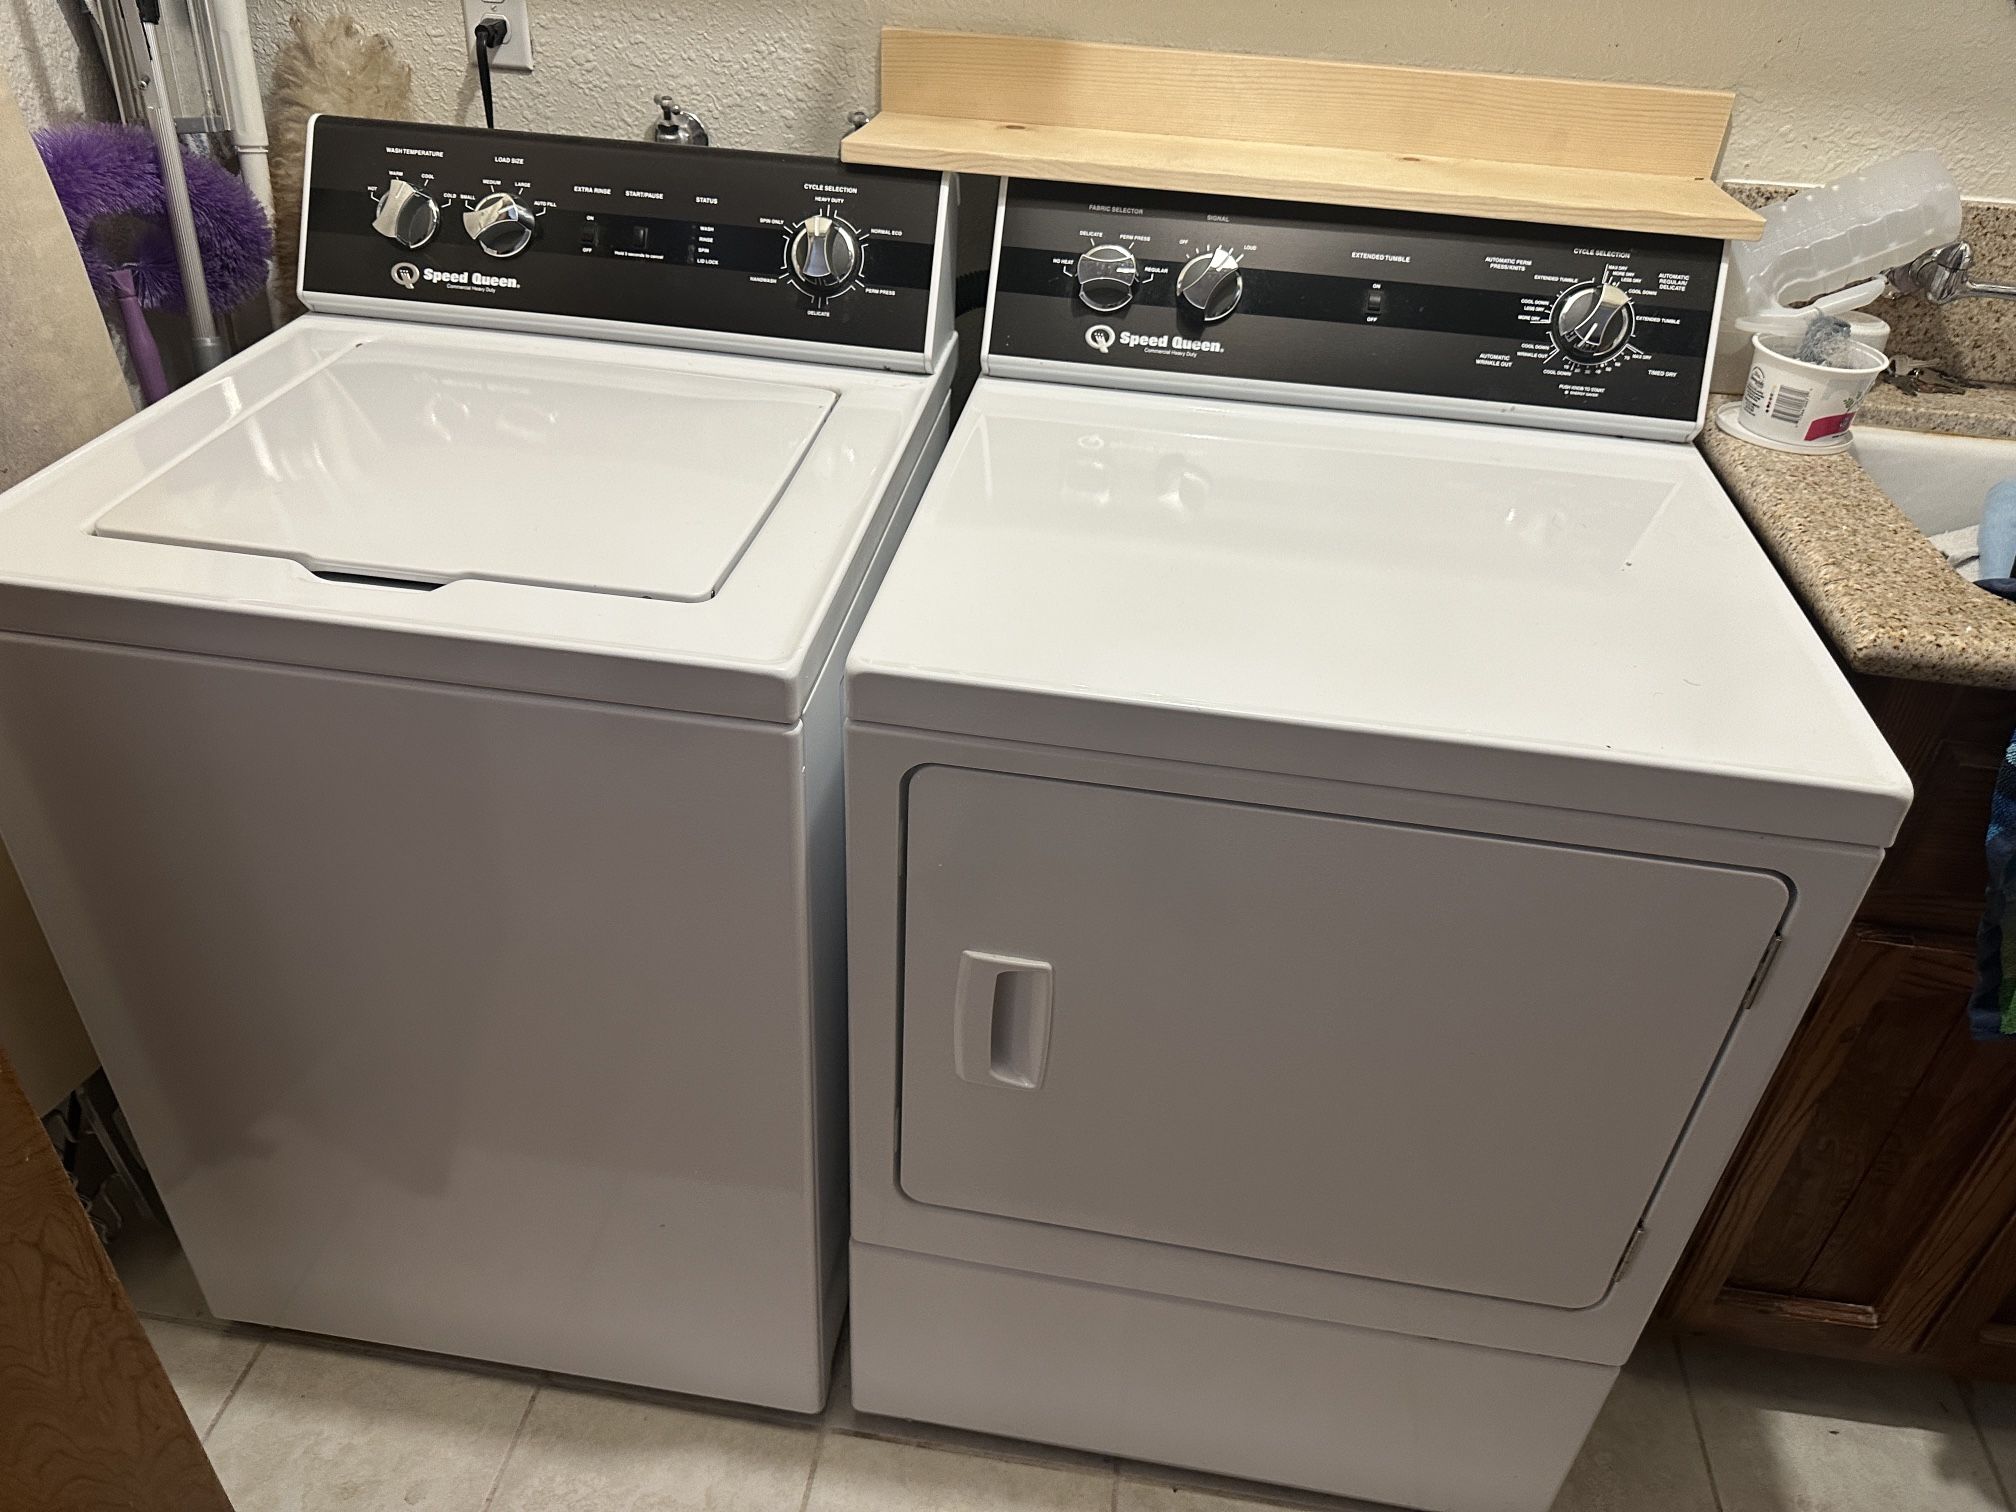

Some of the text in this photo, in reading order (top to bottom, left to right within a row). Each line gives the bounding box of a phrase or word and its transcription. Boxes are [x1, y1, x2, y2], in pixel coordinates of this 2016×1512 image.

[403, 148, 444, 158] TEMPERATURE
[511, 157, 524, 165] SIZE
[573, 185, 611, 195] EXTRA RINSE
[803, 183, 858, 194] CYCLE SELECTION
[625, 190, 664, 200] START/PAUSE
[695, 196, 718, 204] STATUS
[1088, 204, 1144, 215] FABRIC SELECTOR
[1206, 214, 1230, 222] SIGNAL
[1079, 230, 1104, 238] DELICATE
[1351, 251, 1411, 263] EXTENDED TUMBLE
[1573, 248, 1631, 259] CYCLE SELECTION
[1484, 256, 1516, 264] AUTOMATIC
[1144, 266, 1169, 274] REGULAR
[423, 268, 469, 284] Speed
[1658, 272, 1690, 281] AUTOMATIC
[1659, 284, 1686, 292] DELICATE
[1119, 331, 1169, 348] Speed
[1479, 353, 1511, 361] AUTOMATIC
